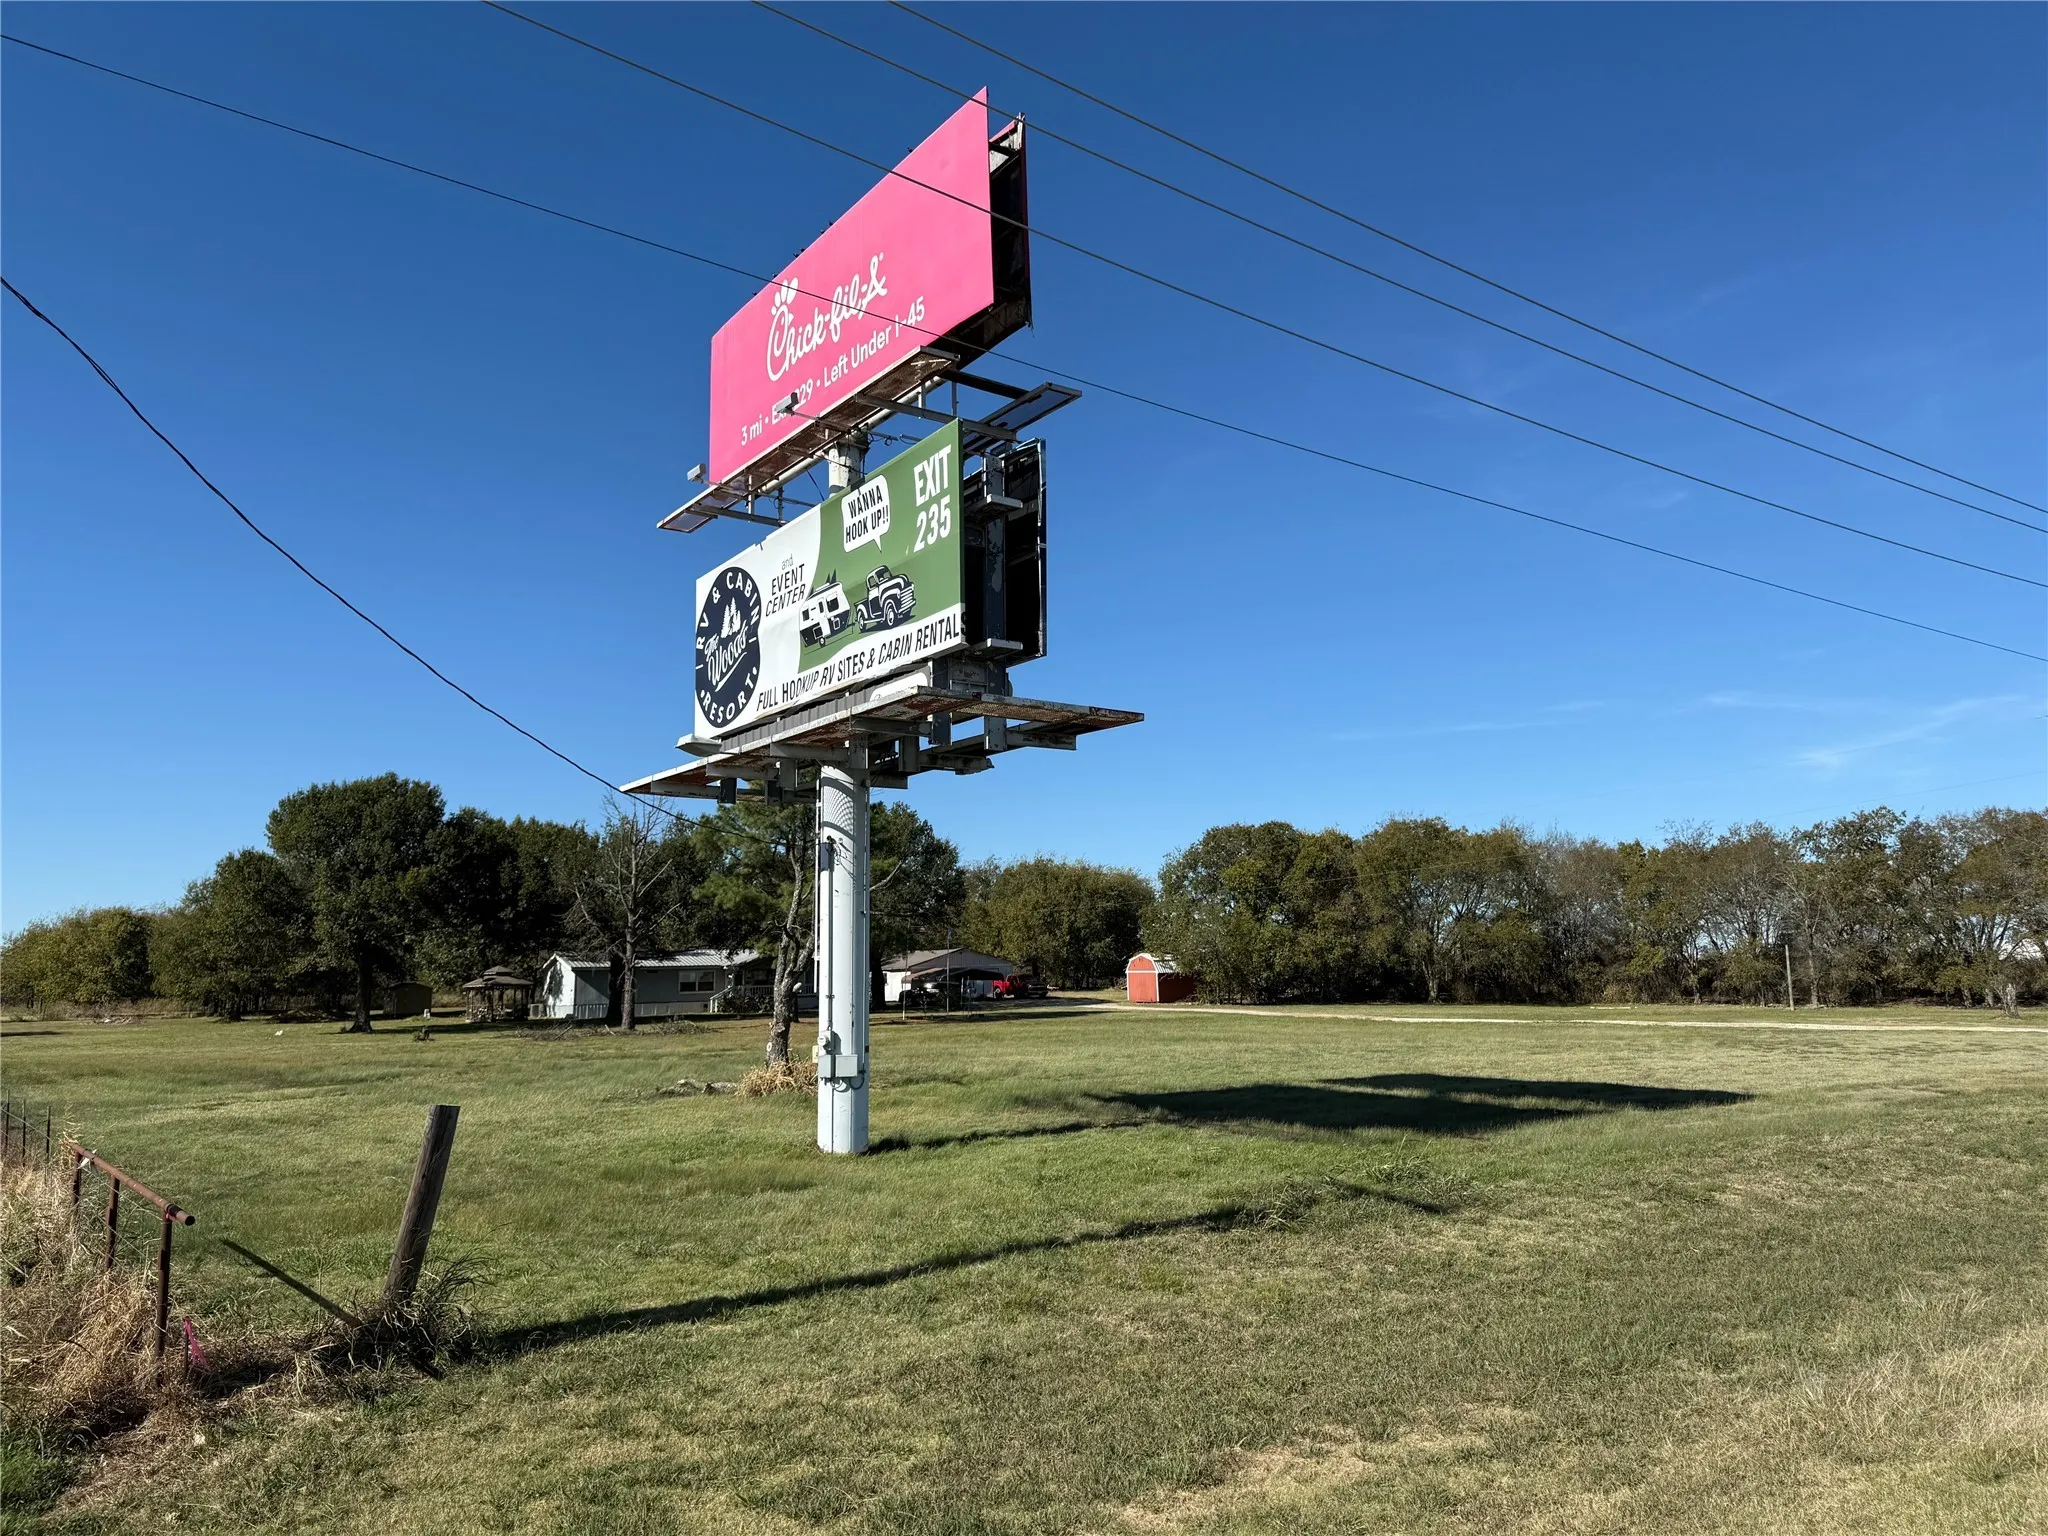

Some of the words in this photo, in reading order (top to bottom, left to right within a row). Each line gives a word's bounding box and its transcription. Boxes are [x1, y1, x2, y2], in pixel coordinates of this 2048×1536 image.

[766, 254, 889, 382] Chick-fil-A
[741, 424, 748, 446] 3
[749, 413, 763, 441] mi
[823, 353, 849, 388] Left
[850, 325, 892, 369] Under
[847, 485, 883, 519] WANNA
[913, 444, 952, 507] EXIT
[845, 516, 868, 544] HOOK
[871, 504, 889, 530] UP!!
[913, 494, 951, 553] 235
[771, 563, 805, 596] EVENT
[781, 553, 794, 571] and
[696, 610, 710, 650] RV
[712, 586, 721, 604] &
[726, 571, 760, 626] CABIN
[765, 583, 806, 617] CENTER
[707, 619, 749, 687] Woods
[756, 686, 778, 712] FULL
[782, 670, 820, 703] HOOKUP
[819, 663, 836, 687] RV
[837, 651, 866, 682] SITES
[866, 647, 876, 669] &
[878, 632, 913, 665] CABIN
[702, 672, 754, 724] RESORT
